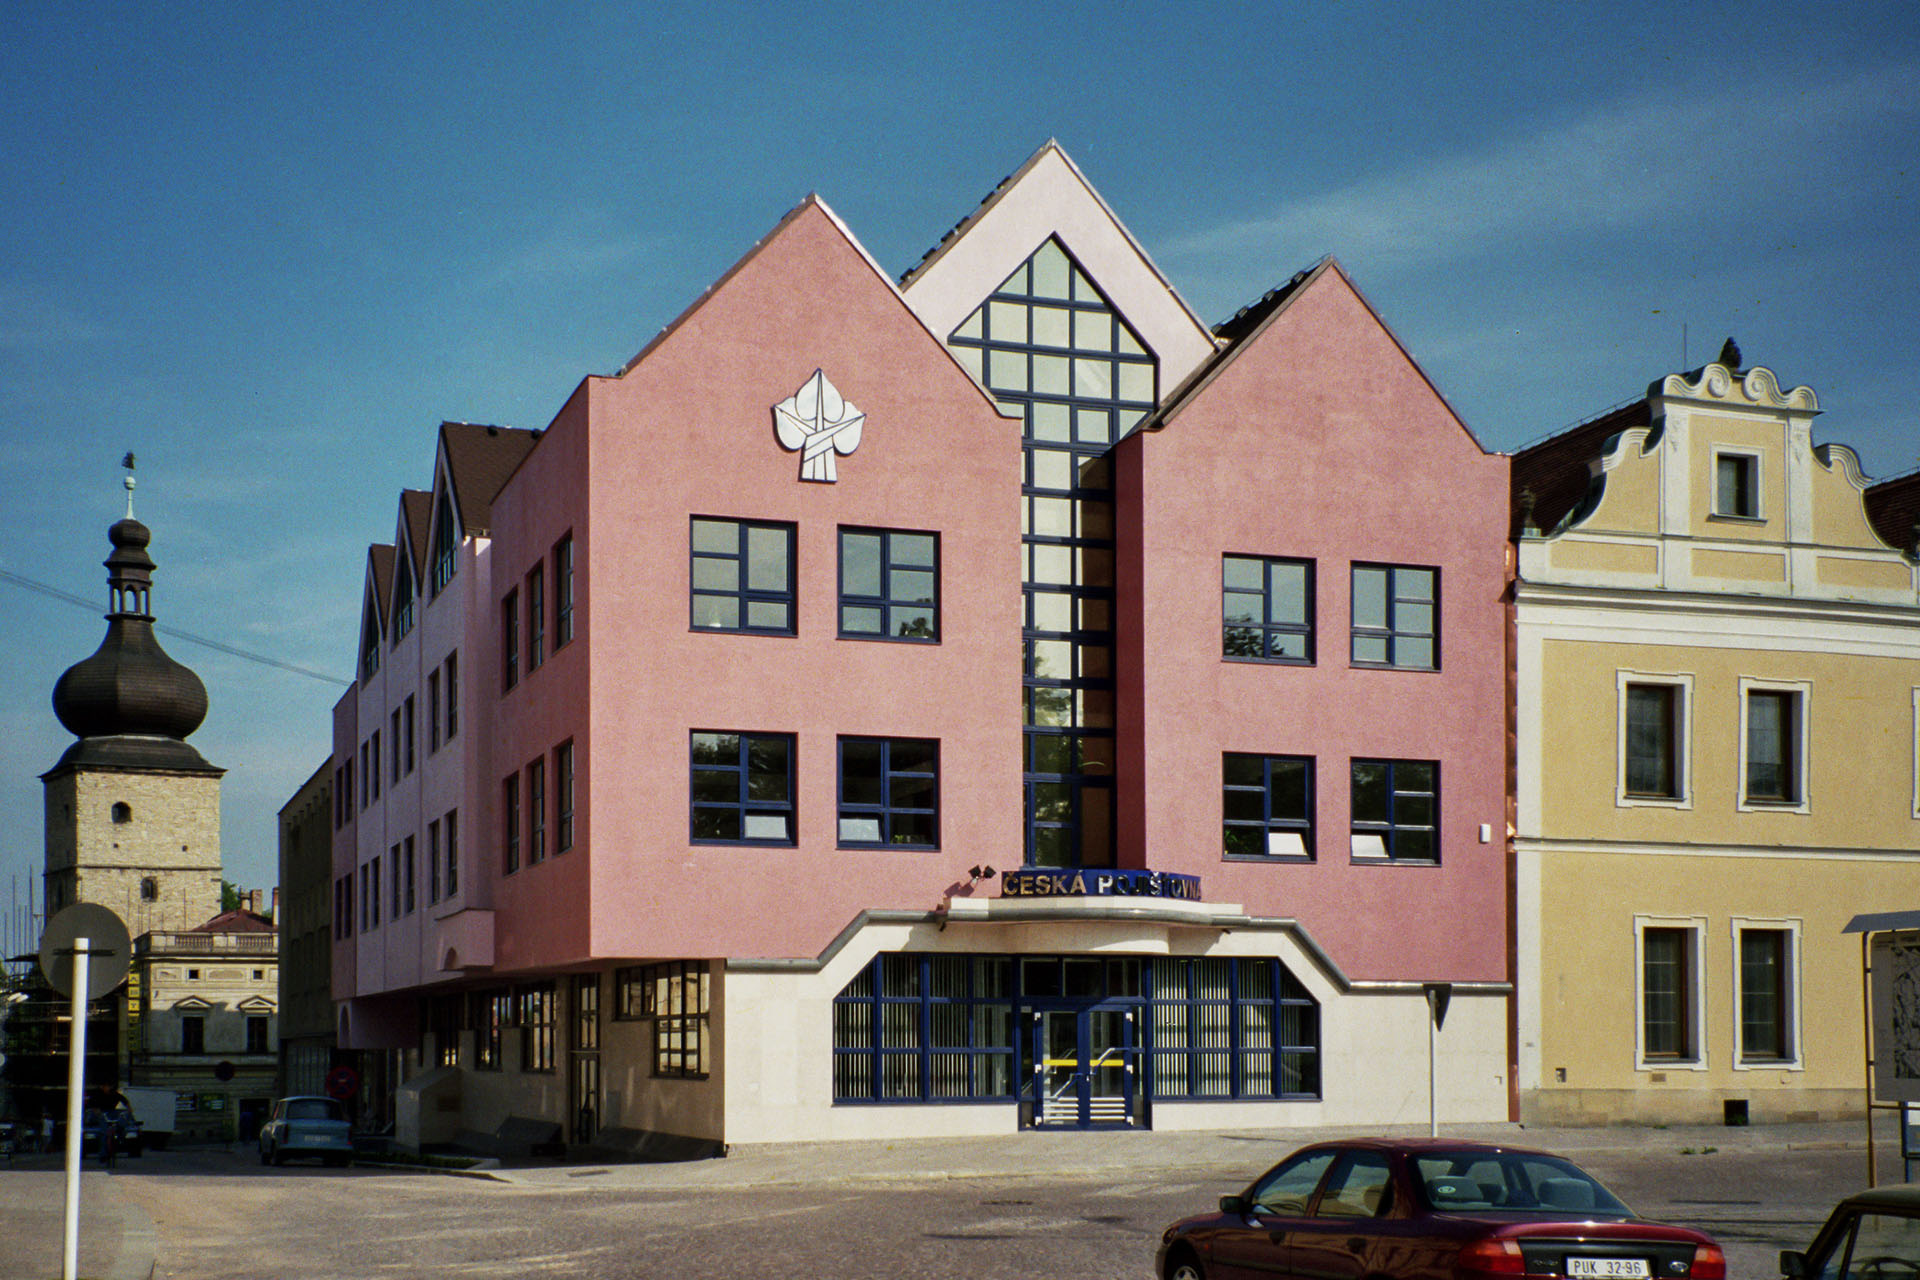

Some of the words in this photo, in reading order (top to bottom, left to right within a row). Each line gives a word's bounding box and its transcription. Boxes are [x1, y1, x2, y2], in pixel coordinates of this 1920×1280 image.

[1002, 870, 1087, 896] ČESKÁ
[1574, 1260, 1597, 1274] PUK
[1607, 1261, 1641, 1275] 32-96
